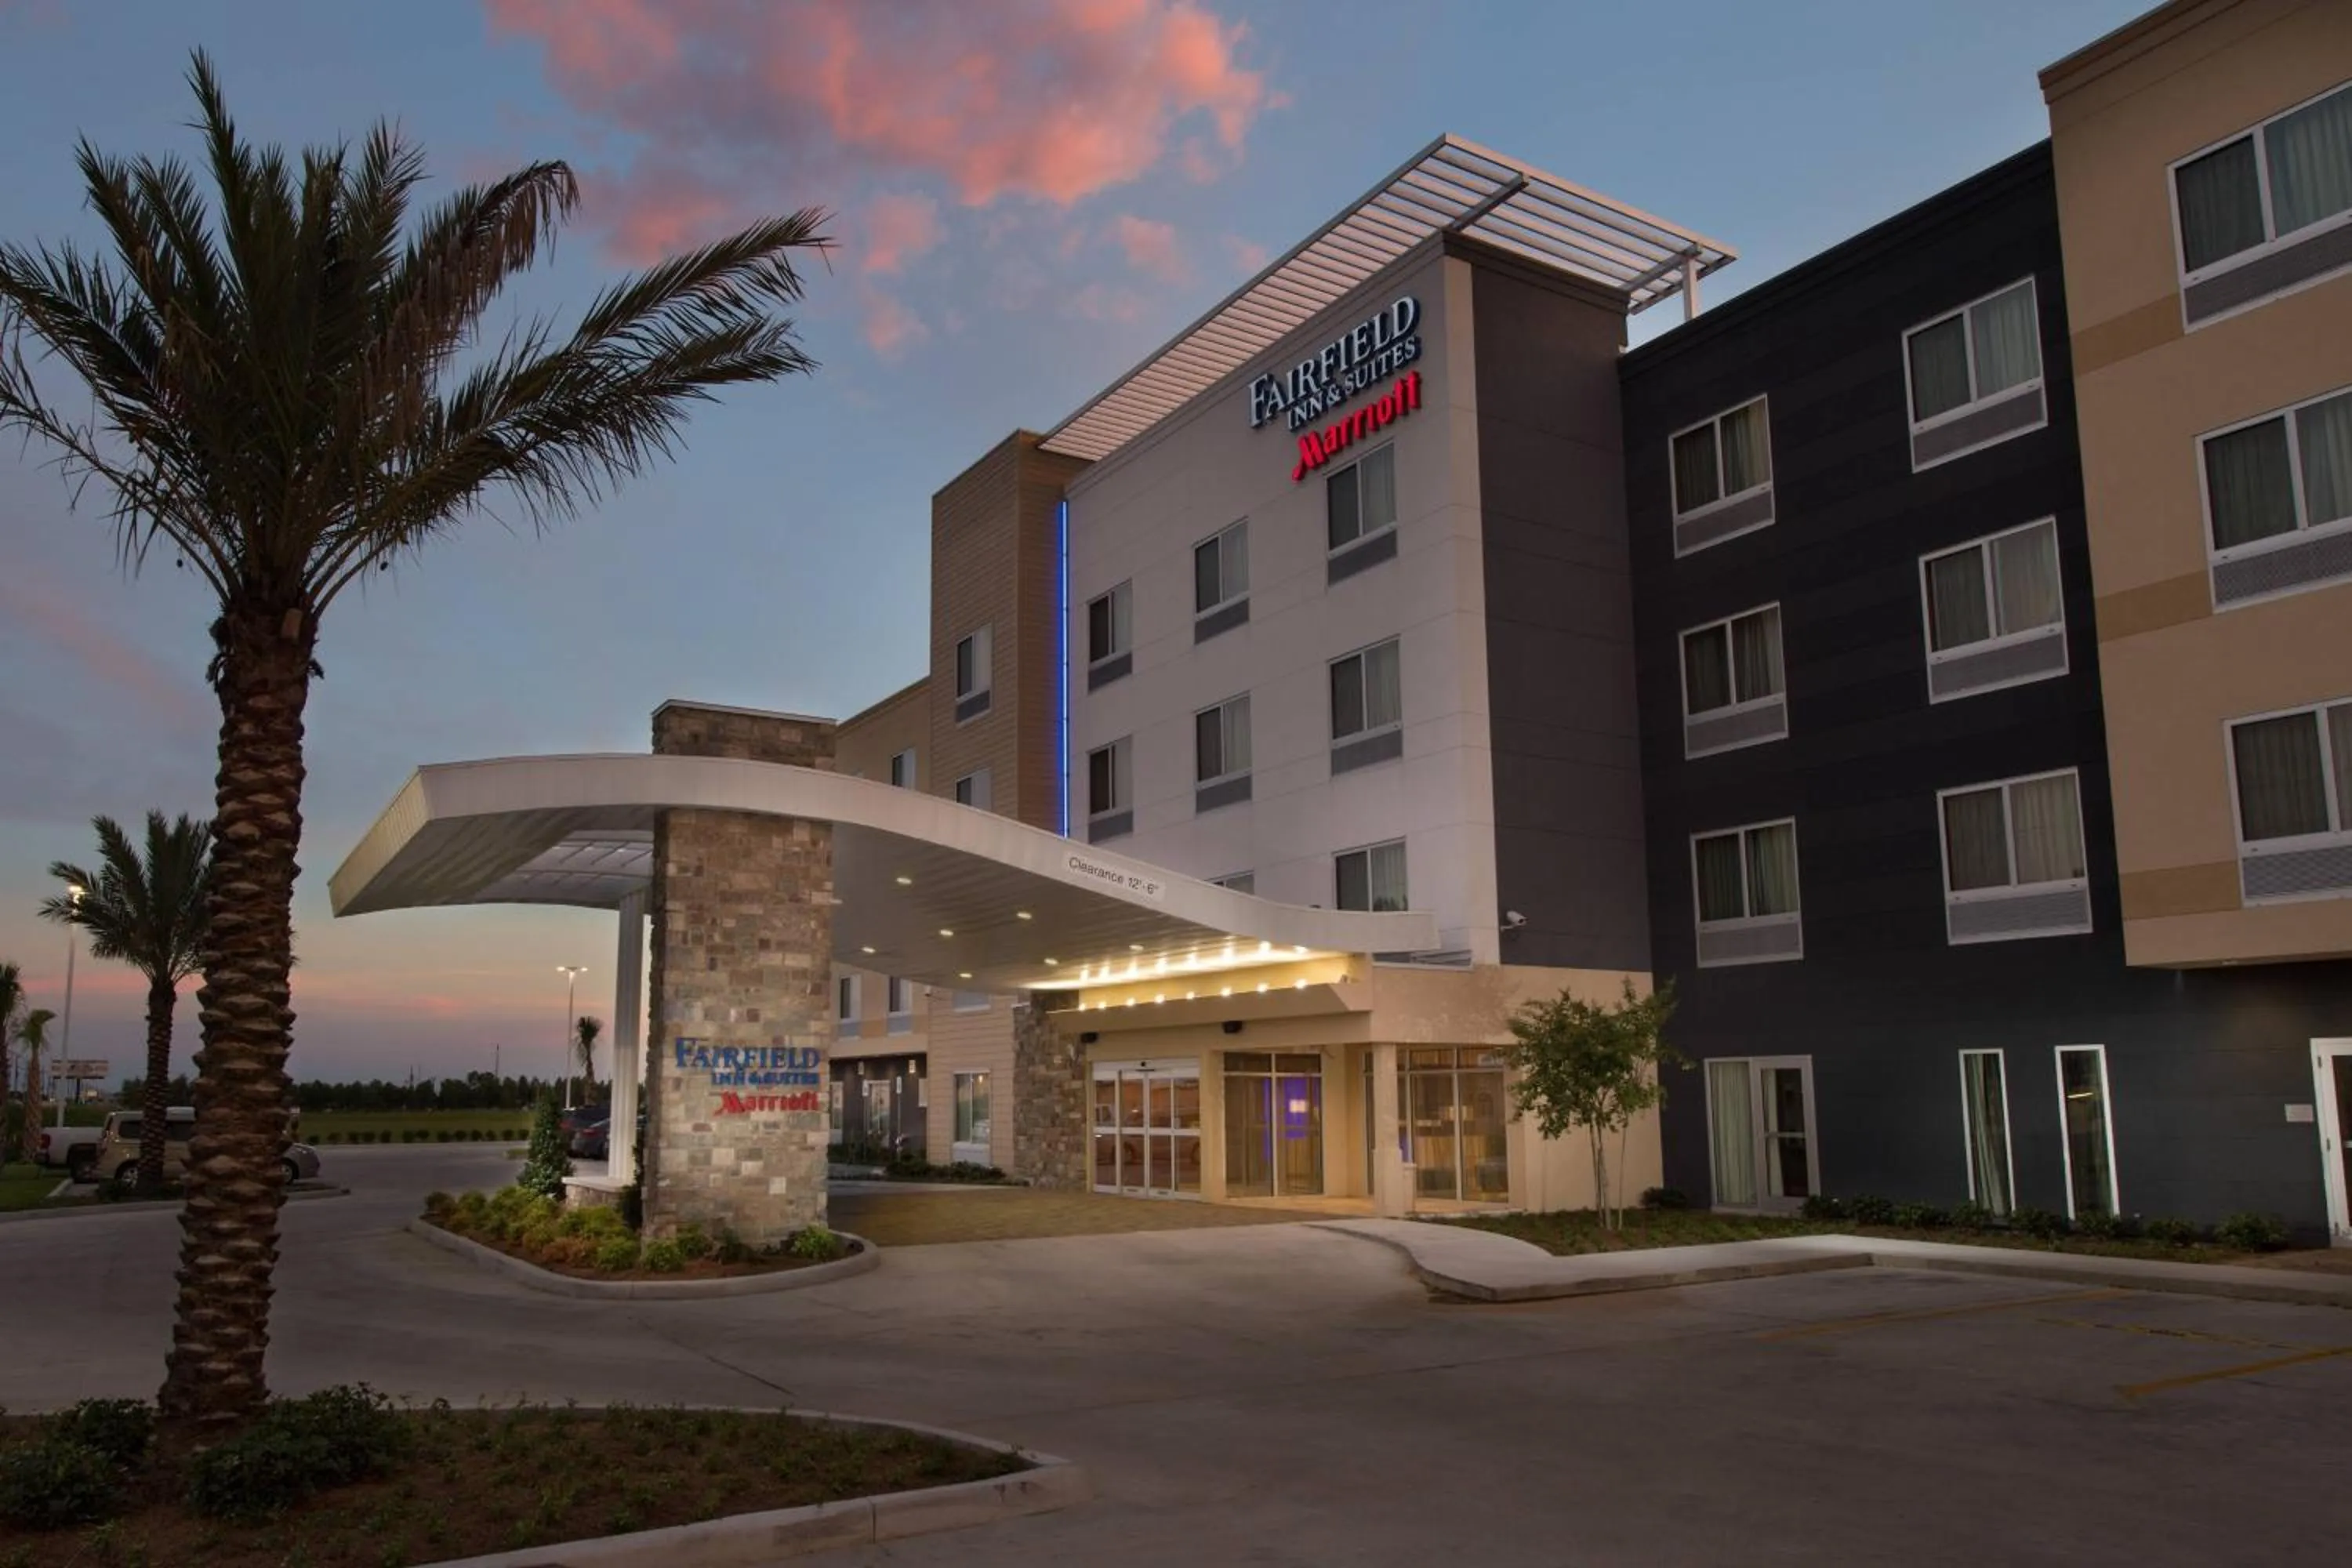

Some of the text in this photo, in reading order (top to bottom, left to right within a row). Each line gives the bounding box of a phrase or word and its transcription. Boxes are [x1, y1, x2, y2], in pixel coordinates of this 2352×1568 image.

[1248, 296, 1421, 428] FAIRFIELD
[1287, 336, 1422, 430] INN & SUITES
[1292, 369, 1423, 481] Marriott
[1069, 857, 1124, 884] Clearance
[675, 1036, 820, 1069] FAIRFIELD
[713, 1091, 819, 1116] Marriott
